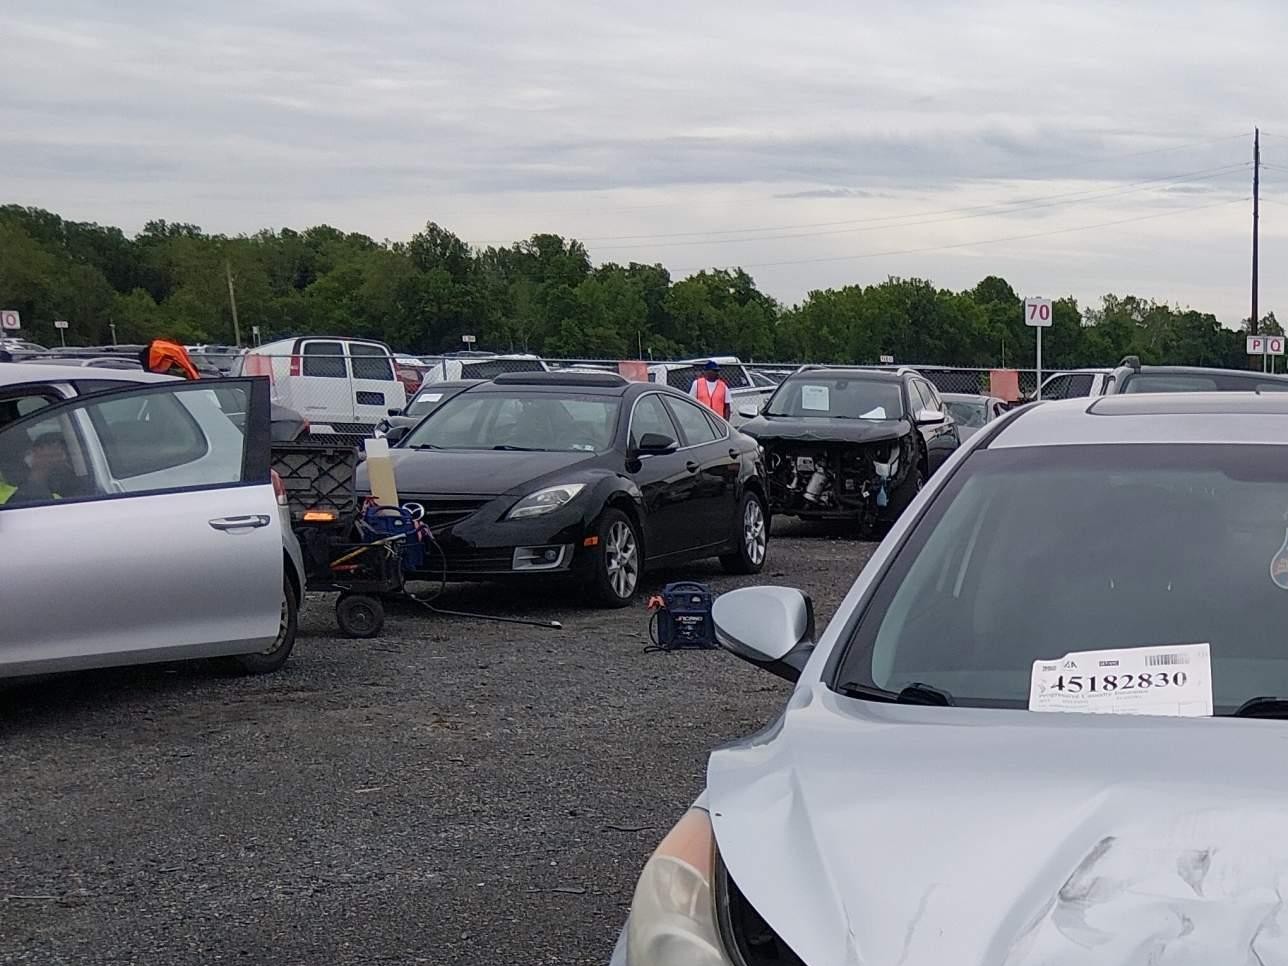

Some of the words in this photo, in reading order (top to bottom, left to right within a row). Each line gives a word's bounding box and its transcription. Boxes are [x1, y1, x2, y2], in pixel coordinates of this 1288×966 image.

[1028, 303, 1050, 321] 70
[1252, 340, 1261, 351] P
[1270, 340, 1282, 352] Q
[1050, 671, 1188, 694] 45182830
